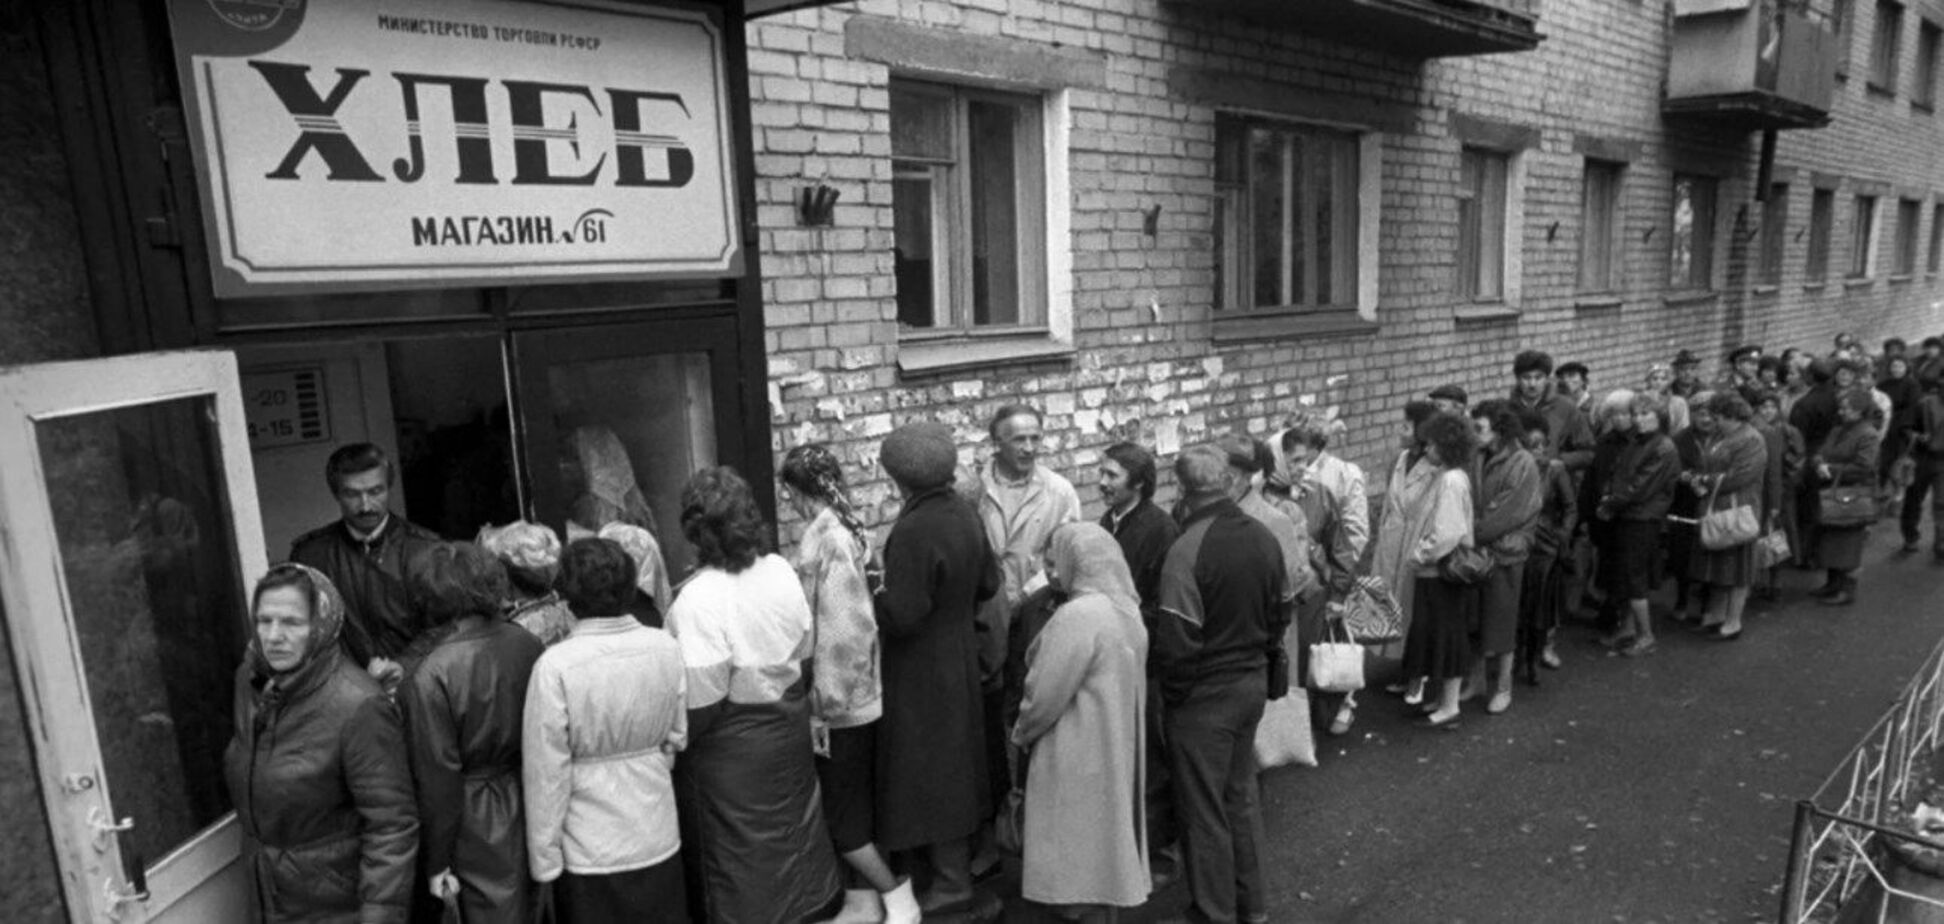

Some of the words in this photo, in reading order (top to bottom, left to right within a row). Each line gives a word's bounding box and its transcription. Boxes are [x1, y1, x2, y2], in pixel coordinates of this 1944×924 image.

[378, 14, 488, 39] МИНИСТЕРСТВО
[493, 26, 557, 46] ТОРГОВЛИ
[561, 33, 600, 50] РСФСР
[248, 60, 694, 187] ХЛЕБ
[411, 216, 553, 246] МАГАЗИН
